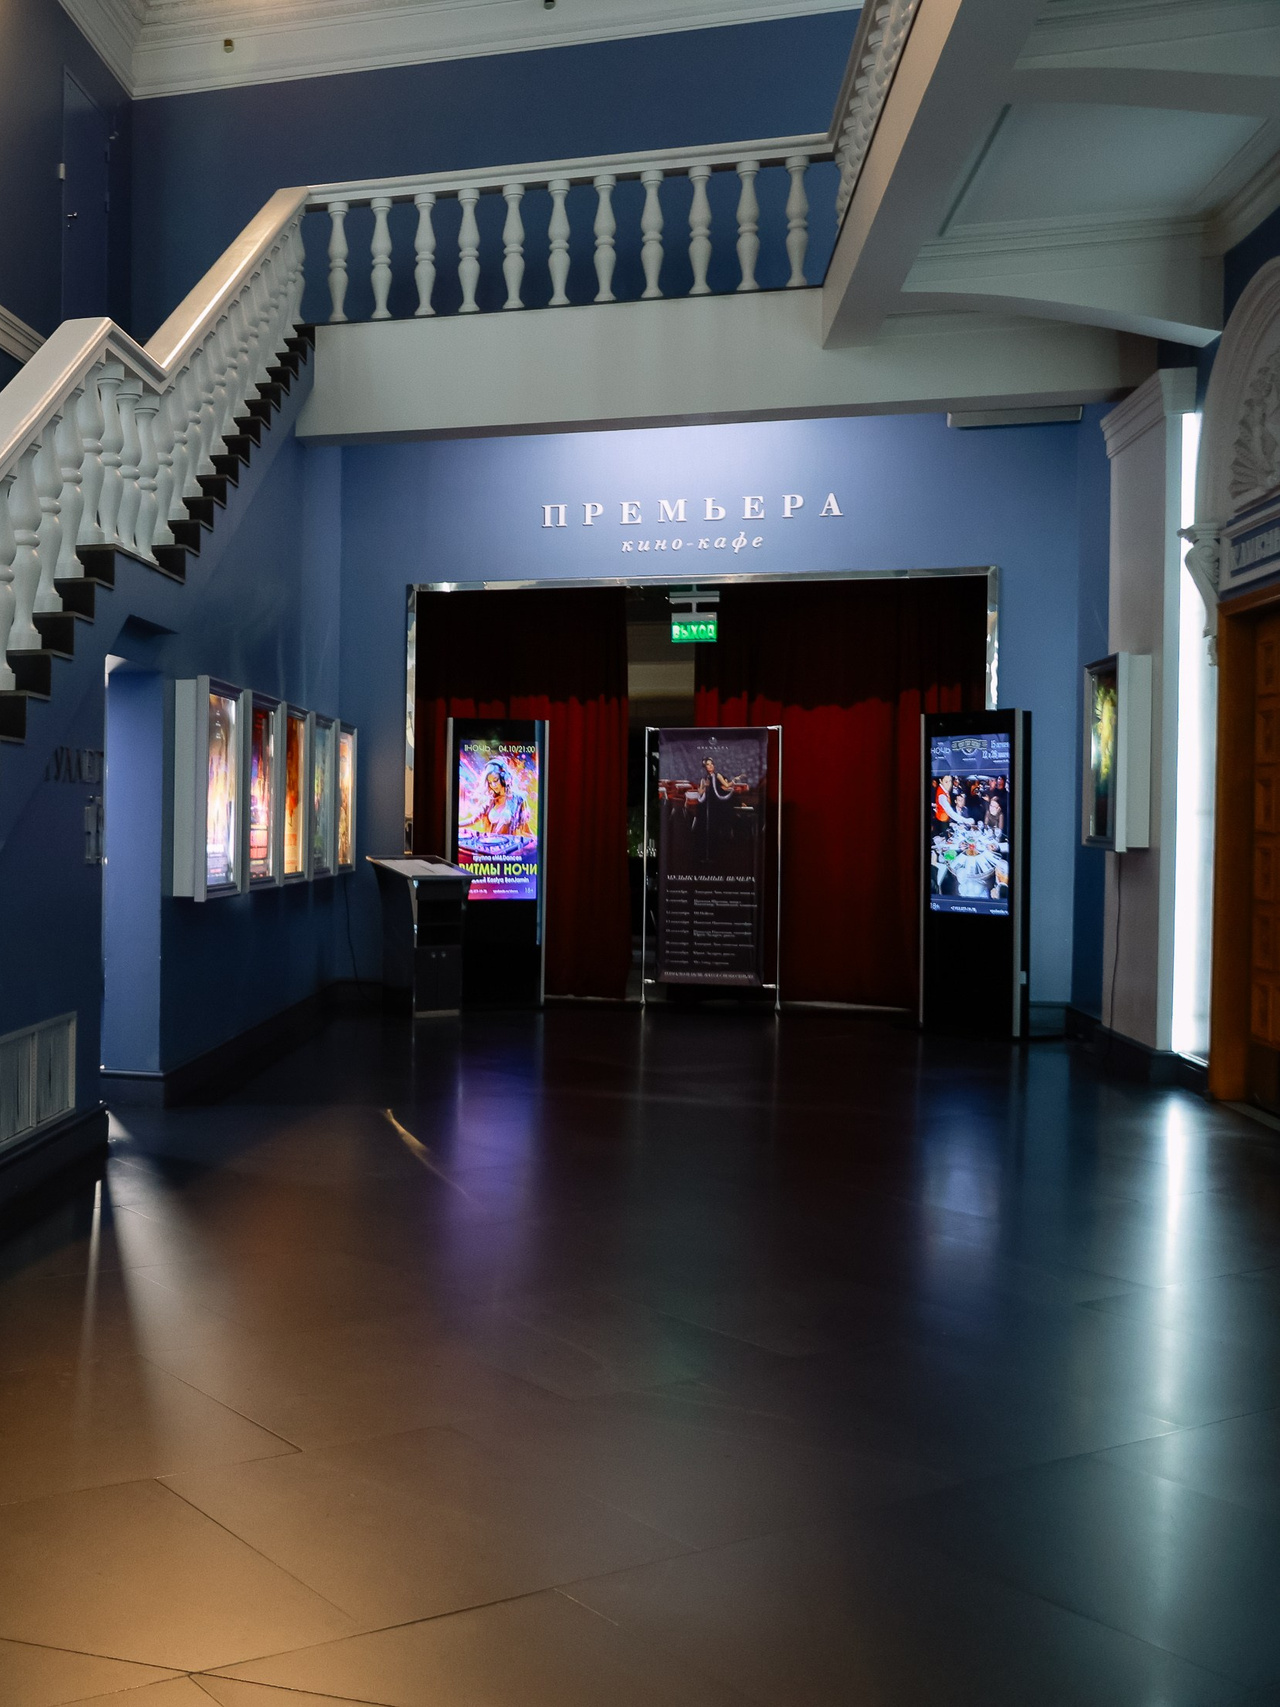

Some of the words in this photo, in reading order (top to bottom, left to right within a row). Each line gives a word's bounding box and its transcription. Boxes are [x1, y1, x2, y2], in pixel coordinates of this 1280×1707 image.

[542, 492, 843, 528] ПРЕМЬЕРА
[621, 532, 763, 554] кино-кафе
[672, 624, 716, 639] ВЫХОД
[504, 863, 537, 875] НОЧИ
